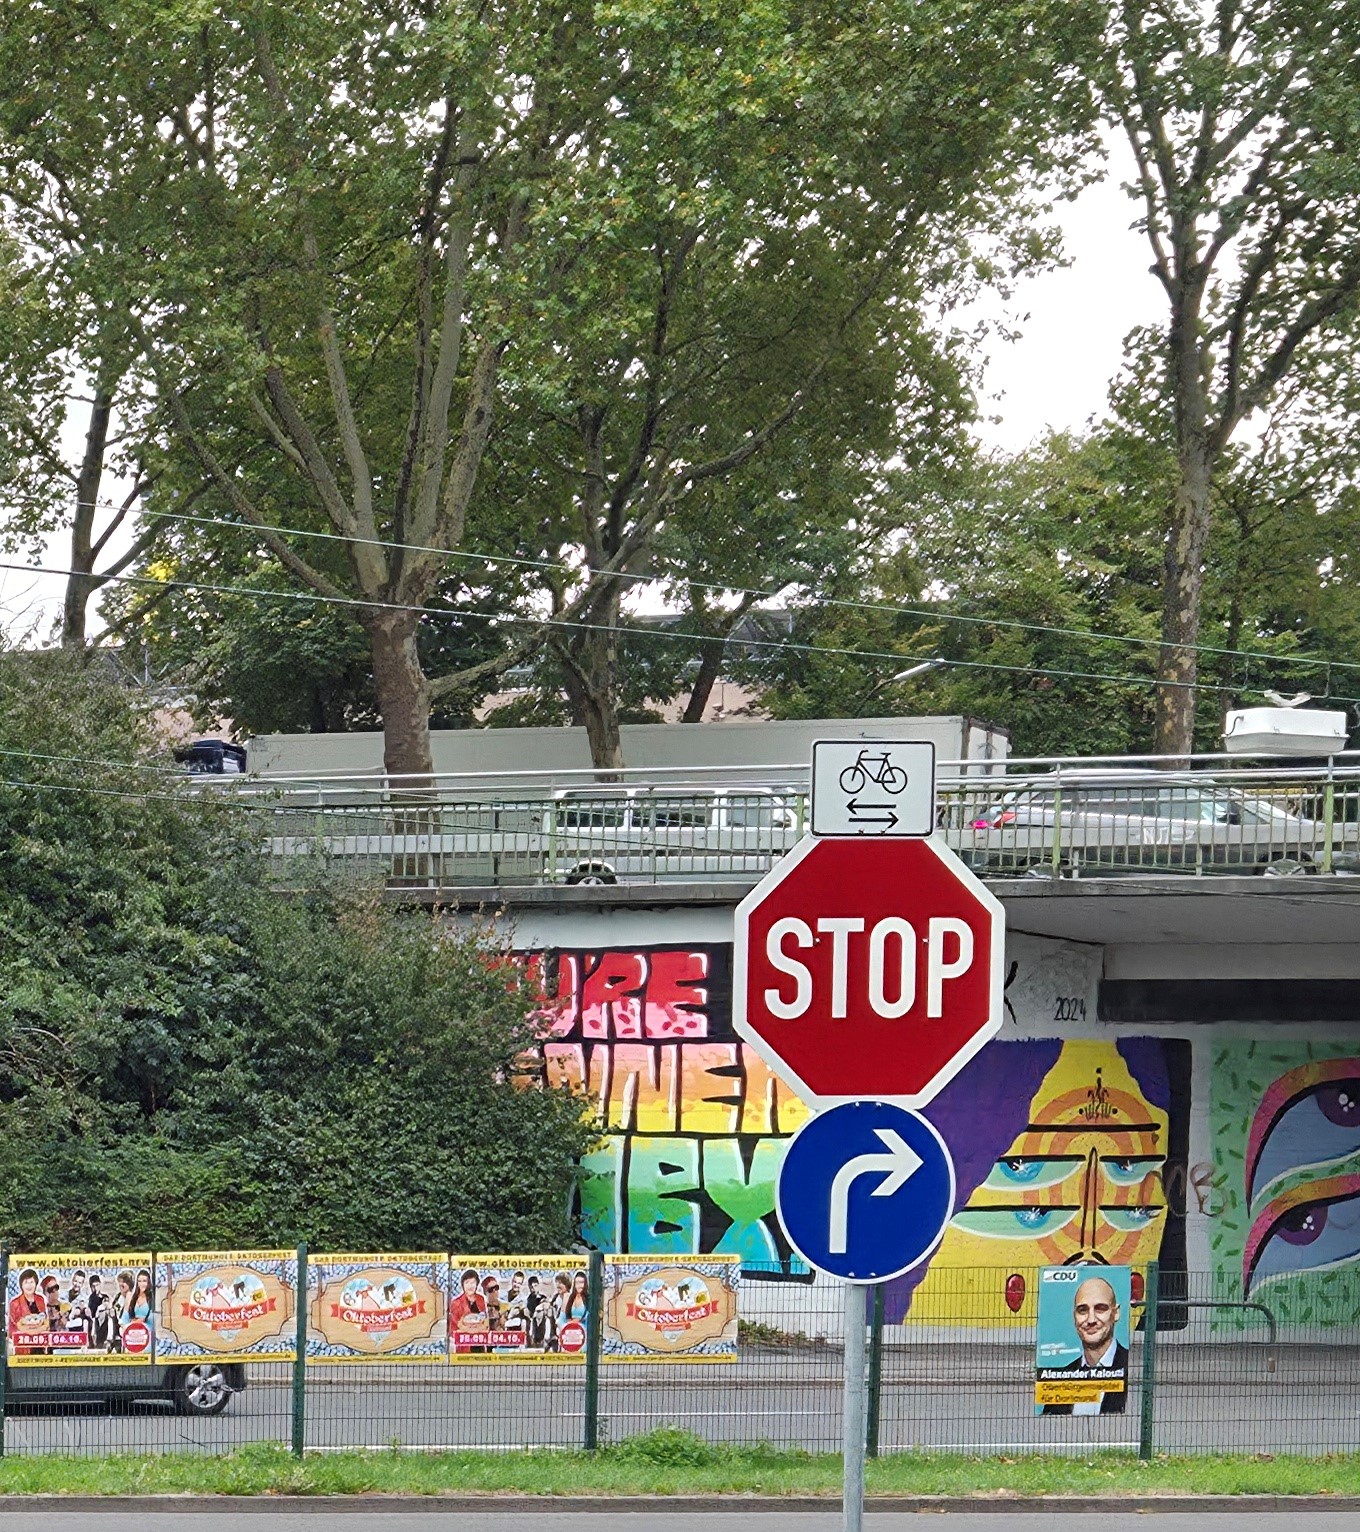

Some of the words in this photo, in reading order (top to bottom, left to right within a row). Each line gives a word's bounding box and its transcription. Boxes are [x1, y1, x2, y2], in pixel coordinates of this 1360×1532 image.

[764, 916, 974, 1020] STOP
[1054, 996, 1087, 1022] 2024
[16, 1257, 151, 1267] www.oktoberfest.nrw
[458, 1259, 587, 1268] www.oktoberfest.nrw
[1053, 1272, 1076, 1281] CDU
[193, 1304, 264, 1322] Oktoberfest
[342, 1306, 414, 1324] Oktoberfest
[638, 1307, 706, 1324] Oktoberfest
[1040, 1369, 1089, 1379] Alexander
